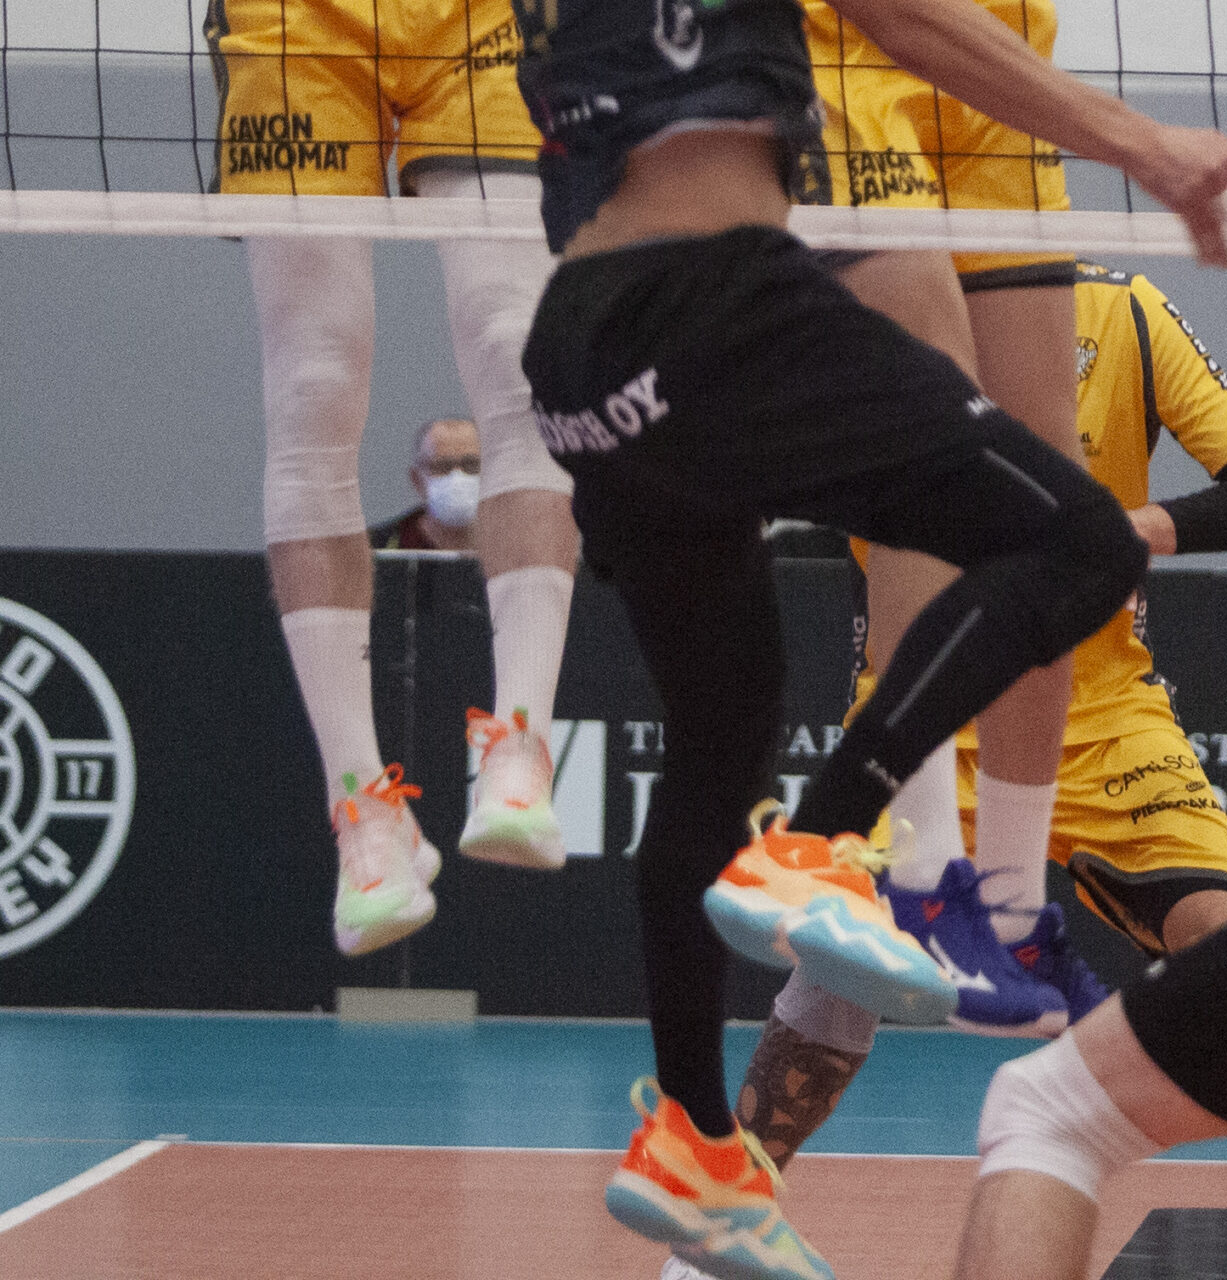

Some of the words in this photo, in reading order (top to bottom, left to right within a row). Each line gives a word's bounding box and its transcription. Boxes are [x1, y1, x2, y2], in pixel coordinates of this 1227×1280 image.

[228, 112, 313, 144] SAVON
[228, 141, 350, 175] SANOMAT
[64, 758, 103, 800] 17
